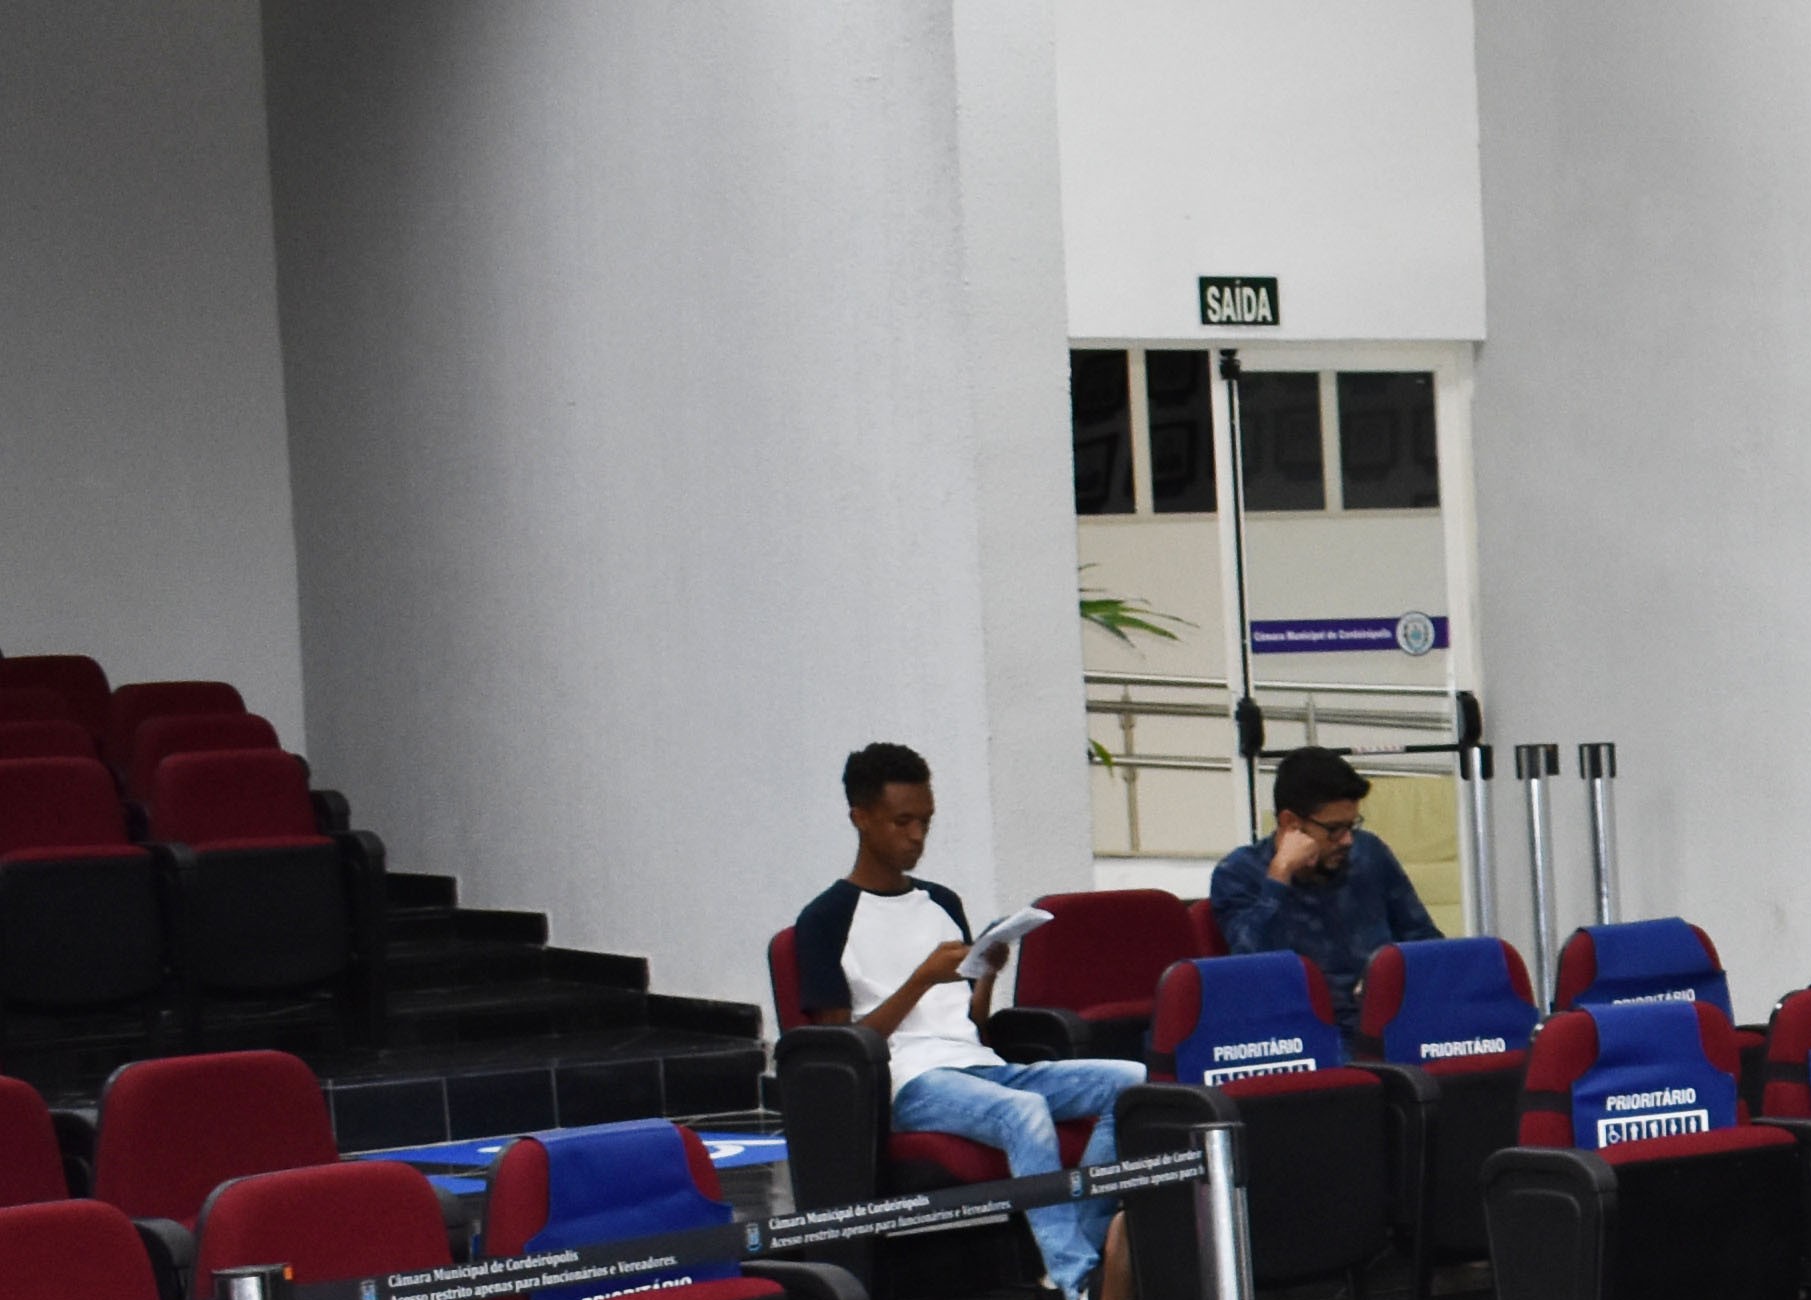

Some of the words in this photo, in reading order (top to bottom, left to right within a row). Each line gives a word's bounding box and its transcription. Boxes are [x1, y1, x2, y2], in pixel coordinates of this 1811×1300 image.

[1206, 279, 1273, 322] SAÍDA
[1213, 1037, 1303, 1062] PRIORITÁRIO
[1421, 1037, 1506, 1058] PRIORITÁRIO
[1606, 1087, 1696, 1111] PRIORITÁRIO
[806, 1205, 855, 1224] Municipal
[855, 1203, 867, 1216] de
[388, 1272, 431, 1288] Câmara
[433, 1262, 489, 1282] Municipal
[490, 1260, 504, 1273] de
[474, 1280, 513, 1298] apenas
[515, 1276, 540, 1293] para
